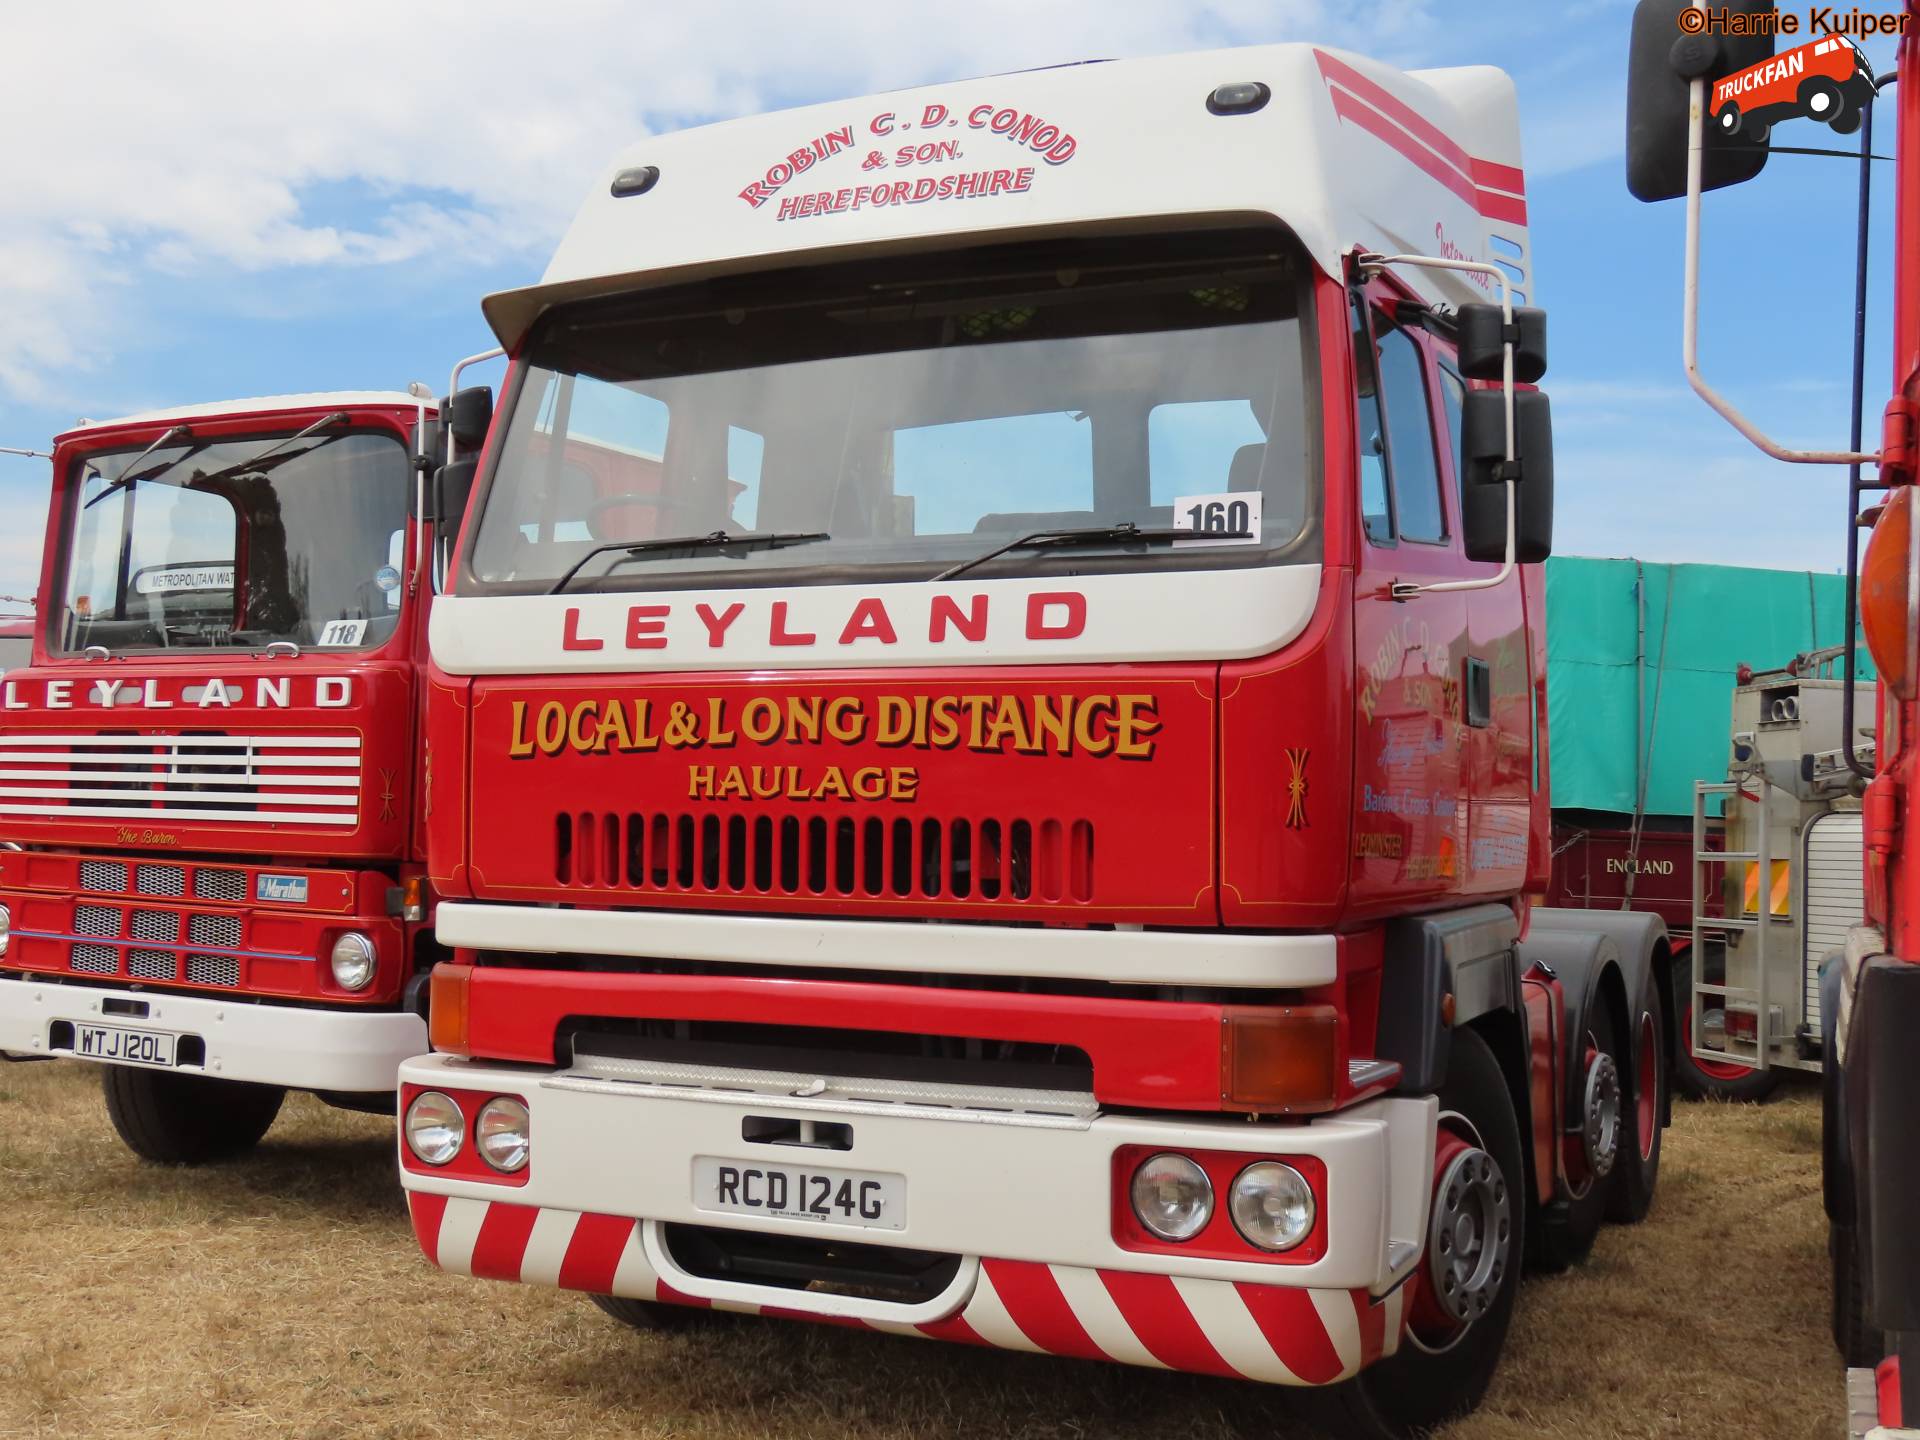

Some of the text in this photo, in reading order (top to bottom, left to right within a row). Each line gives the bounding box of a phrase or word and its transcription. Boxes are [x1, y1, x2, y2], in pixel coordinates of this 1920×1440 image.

[738, 125, 855, 208] ROBIN
[967, 104, 1079, 166] CONOD
[861, 139, 963, 171] & SON.
[776, 167, 1034, 221] HEREFORDSHIRE
[1187, 500, 1249, 534] 160
[152, 573, 214, 587] METROPOLITAN
[328, 624, 358, 644] 118
[562, 591, 1088, 651] LEYLAND
[5, 676, 351, 709] LEYLAND
[509, 694, 1163, 761] LOCAL & LONG DISTANCE
[688, 765, 919, 800] HAULAGE
[264, 878, 306, 899] Marathon
